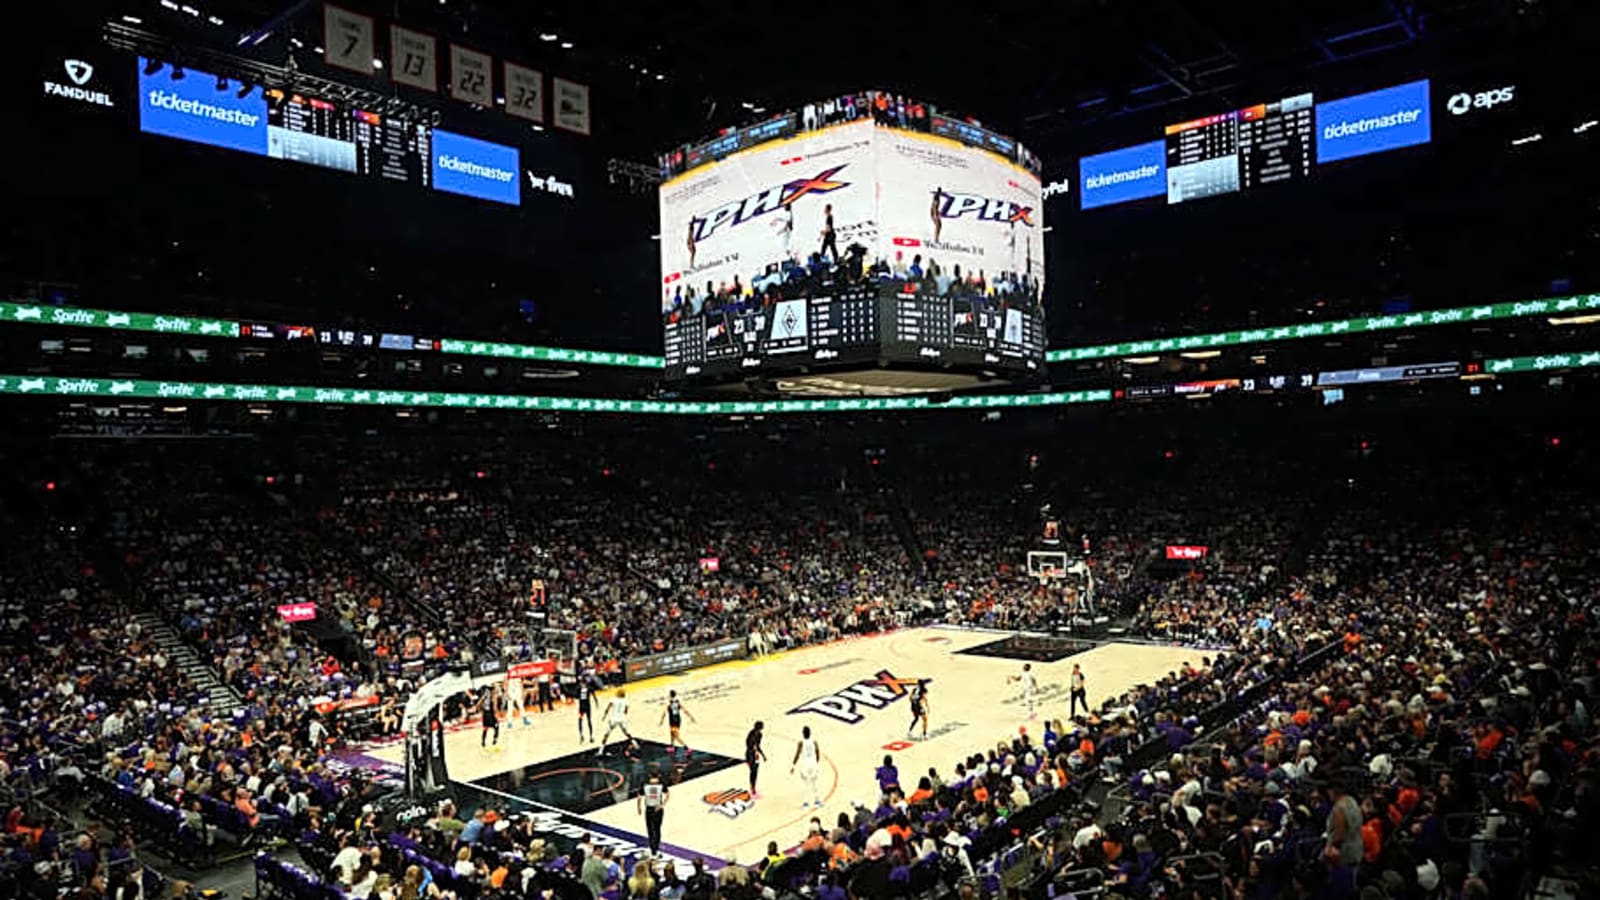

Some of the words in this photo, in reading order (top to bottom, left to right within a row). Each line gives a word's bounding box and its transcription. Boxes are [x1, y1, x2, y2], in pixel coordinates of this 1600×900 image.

[341, 34, 358, 57] 7
[403, 53, 425, 77] 13
[44, 81, 114, 107] FANDUEL
[460, 70, 486, 95] 22
[149, 90, 260, 128] ticketmaster
[513, 86, 537, 110] 32
[1473, 86, 1514, 109] aps
[1323, 108, 1422, 140] ticketmaster
[438, 154, 515, 183] ticketmaster
[1086, 164, 1160, 190] ticketmaster
[689, 163, 853, 243] PHX
[931, 190, 1035, 227] PHX
[52, 308, 96, 325] Sprite
[153, 316, 192, 332] Sprite
[1366, 317, 1397, 330] Sprite
[1430, 310, 1463, 324] Sprite
[1512, 301, 1548, 316] Sprite
[320, 331, 331, 343] 23
[1534, 356, 1571, 370] Sprite
[56, 378, 99, 394] Sprite
[157, 383, 195, 398] Sprite
[233, 385, 267, 400] Sprite
[314, 388, 345, 402] Sprite
[1243, 379, 1255, 391] 23
[786, 668, 932, 725] PHX
